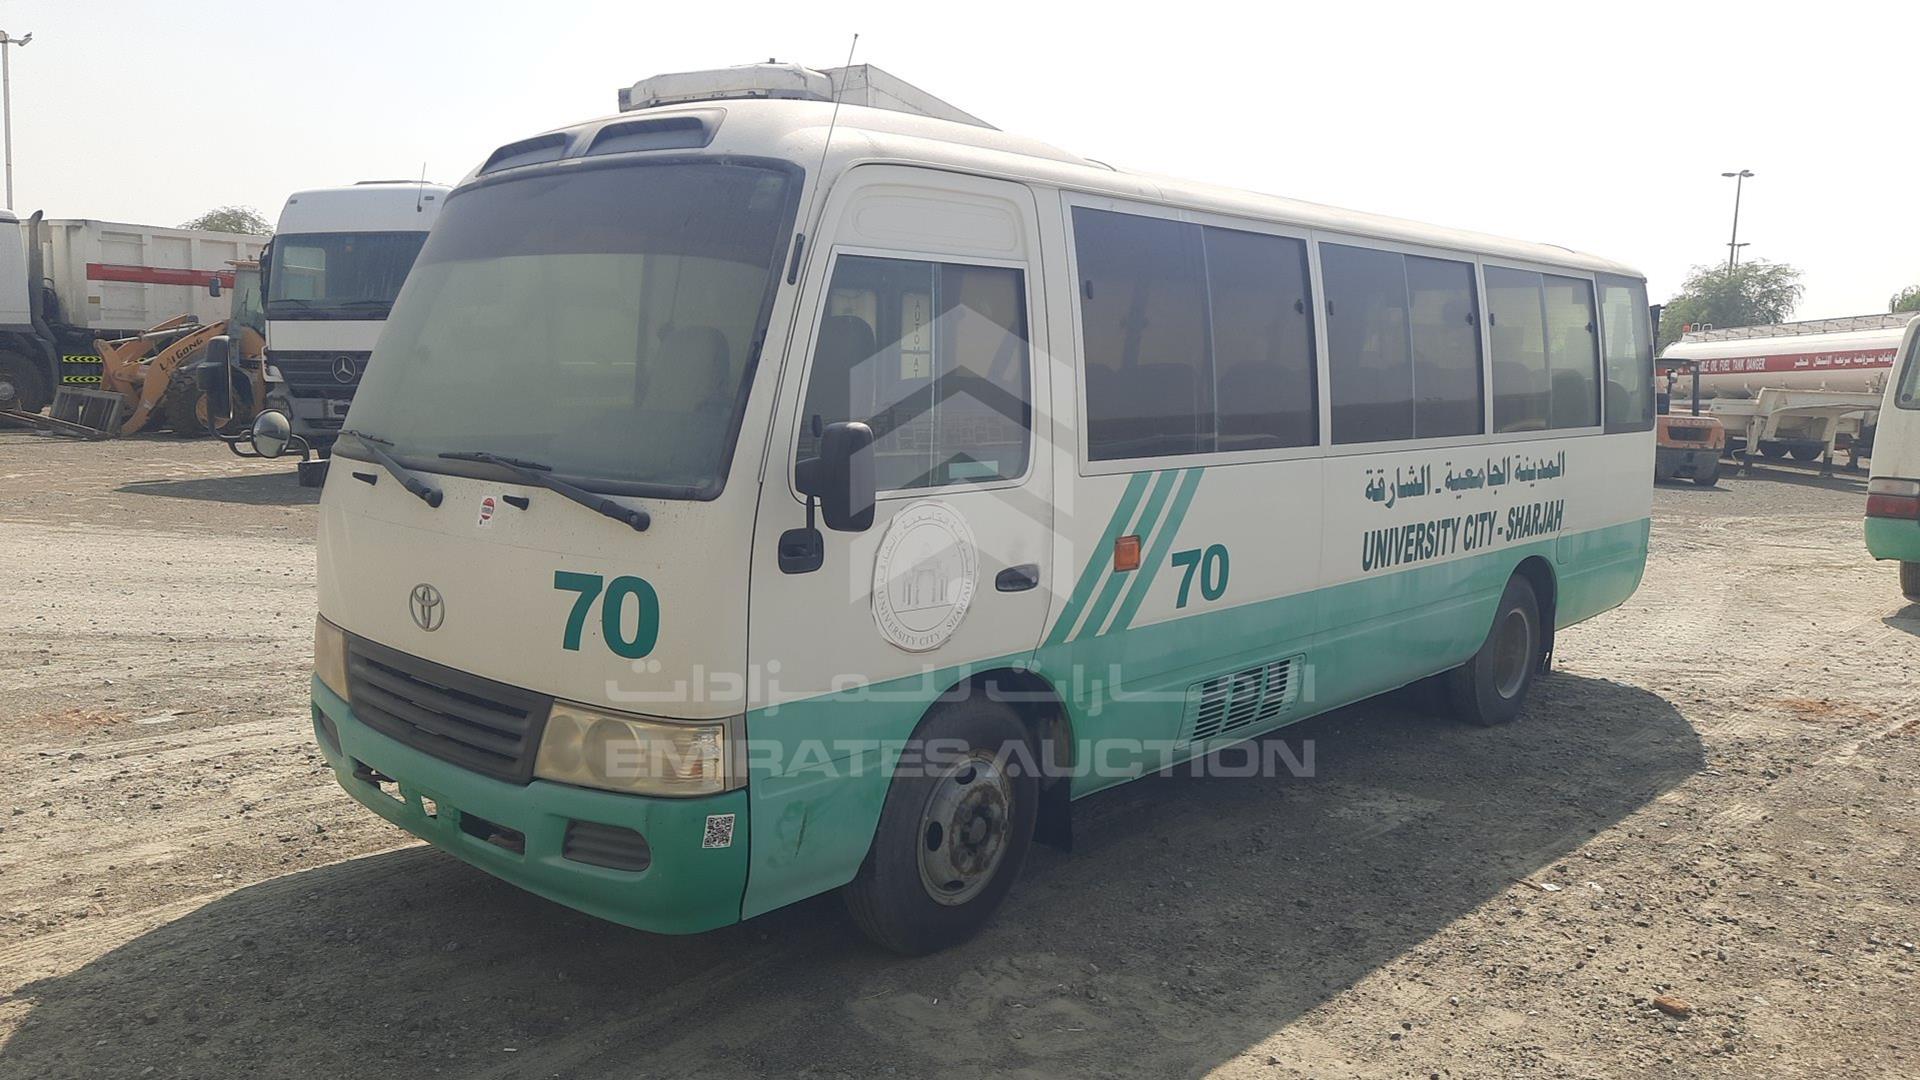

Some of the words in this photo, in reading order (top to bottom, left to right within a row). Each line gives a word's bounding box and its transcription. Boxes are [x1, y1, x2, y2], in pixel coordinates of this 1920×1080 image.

[1720, 360, 1730, 371] FUEL
[1732, 359, 1745, 370] TANK
[1746, 358, 1766, 370] DANGER
[1364, 463, 1432, 509] الشارقة
[1444, 455, 1511, 500] الجامعية
[1514, 450, 1566, 488] المدينة
[1362, 516, 1461, 572] UNIVERSITY
[1463, 510, 1498, 551] CITY
[1506, 499, 1565, 542] SHARJAH
[1171, 543, 1230, 610] 70
[553, 570, 661, 660] 70
[877, 590, 915, 646] UNIVERSITY
[919, 632, 942, 646] CITY
